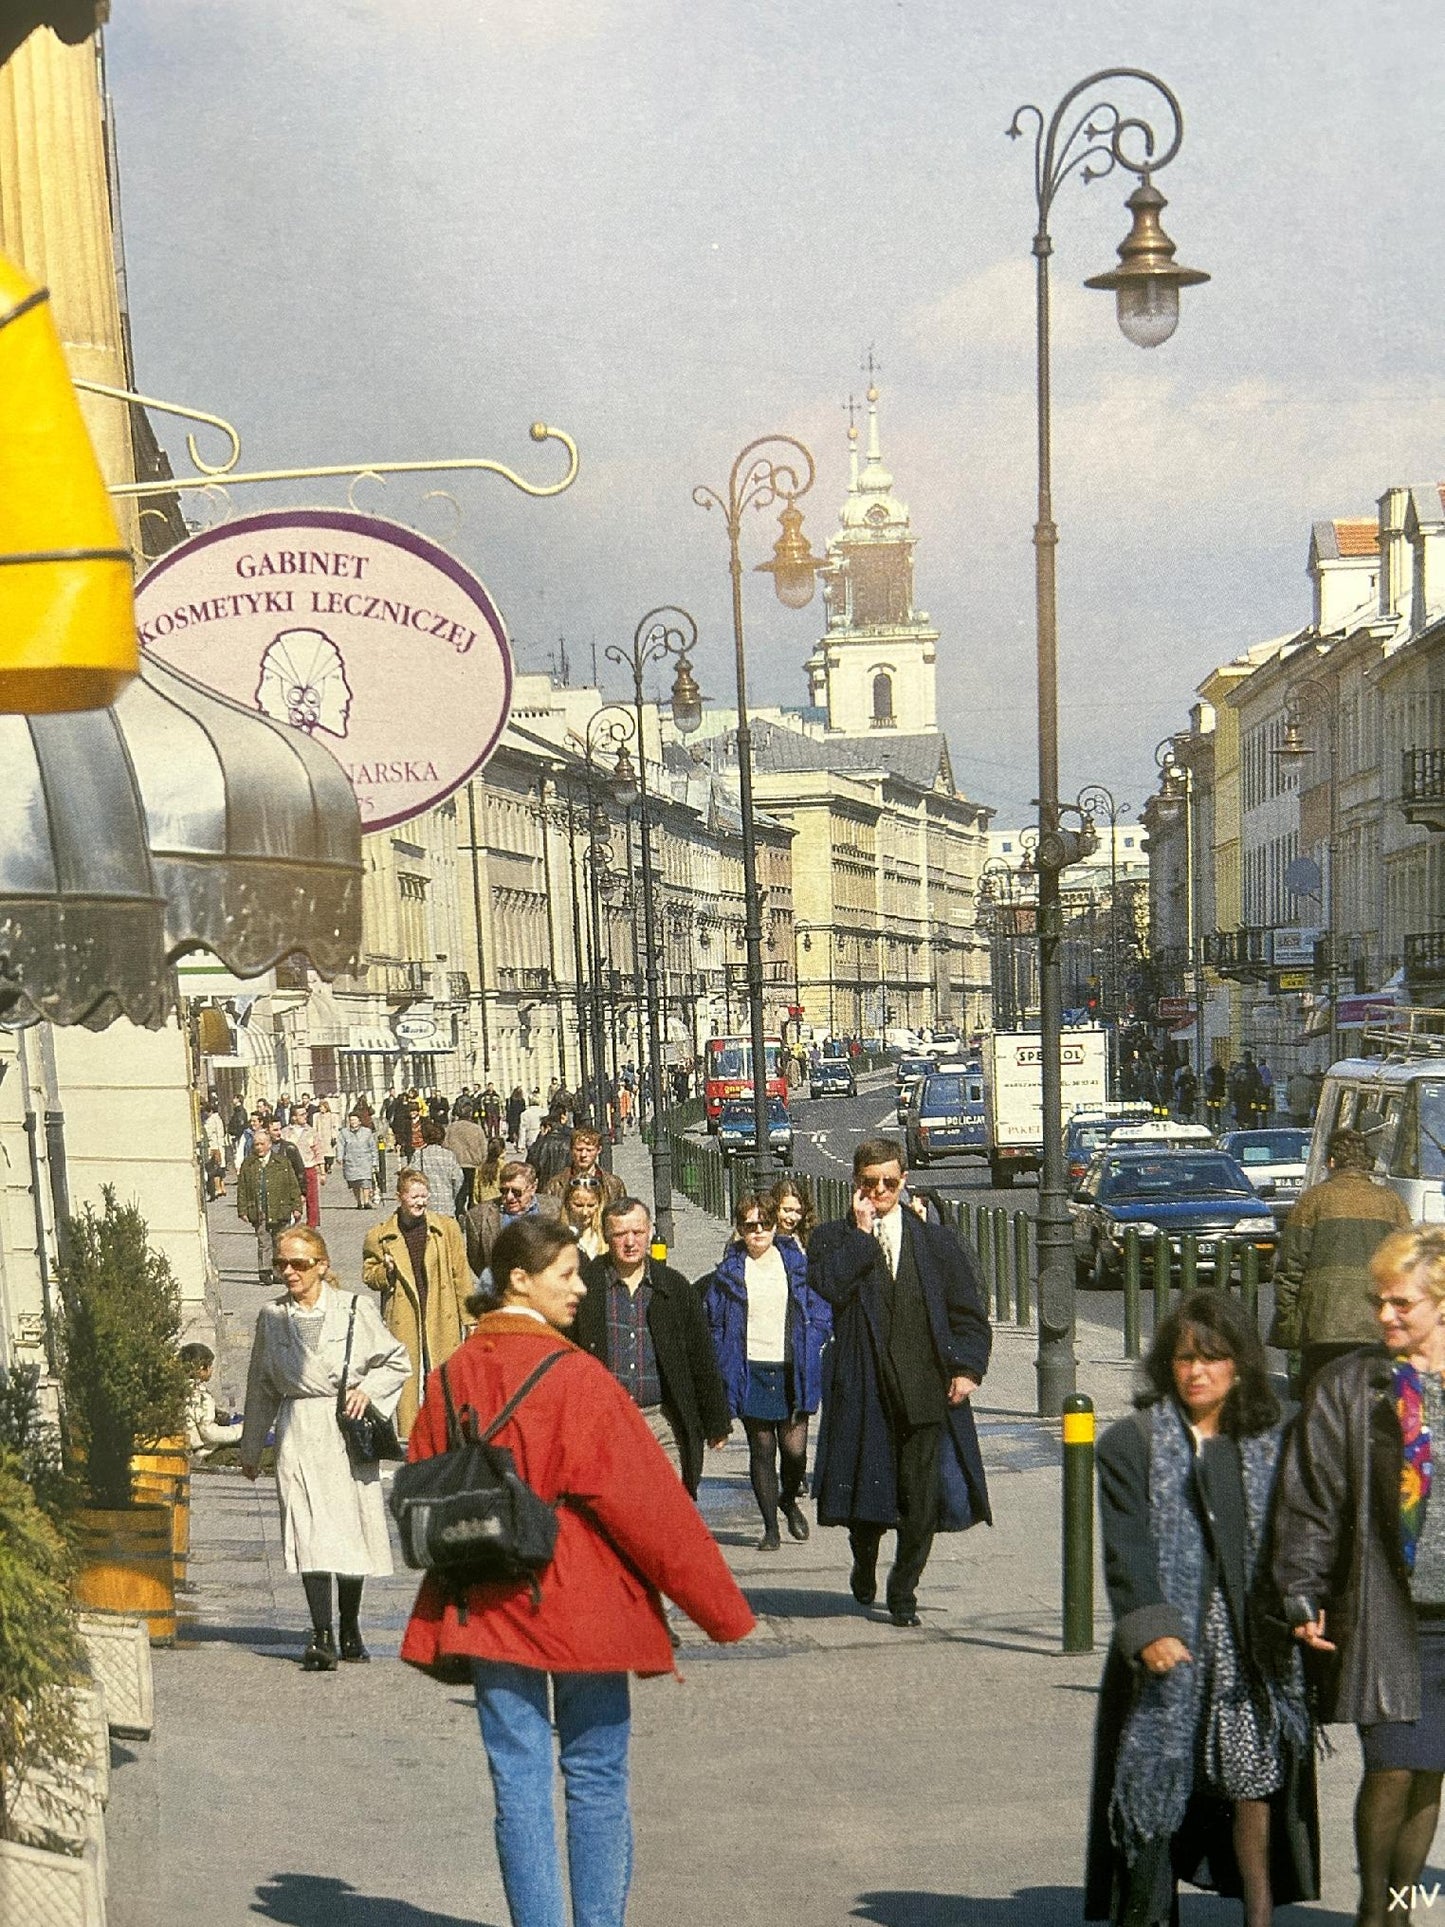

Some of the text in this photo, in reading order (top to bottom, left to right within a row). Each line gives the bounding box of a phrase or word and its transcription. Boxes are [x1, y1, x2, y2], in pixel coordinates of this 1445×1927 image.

[236, 551, 369, 579] GABINET
[137, 590, 477, 654] KOSMETYKI LECZNICZEJ
[1019, 1050, 1081, 1062] SPEOL
[946, 1115, 985, 1126] POLICJA
